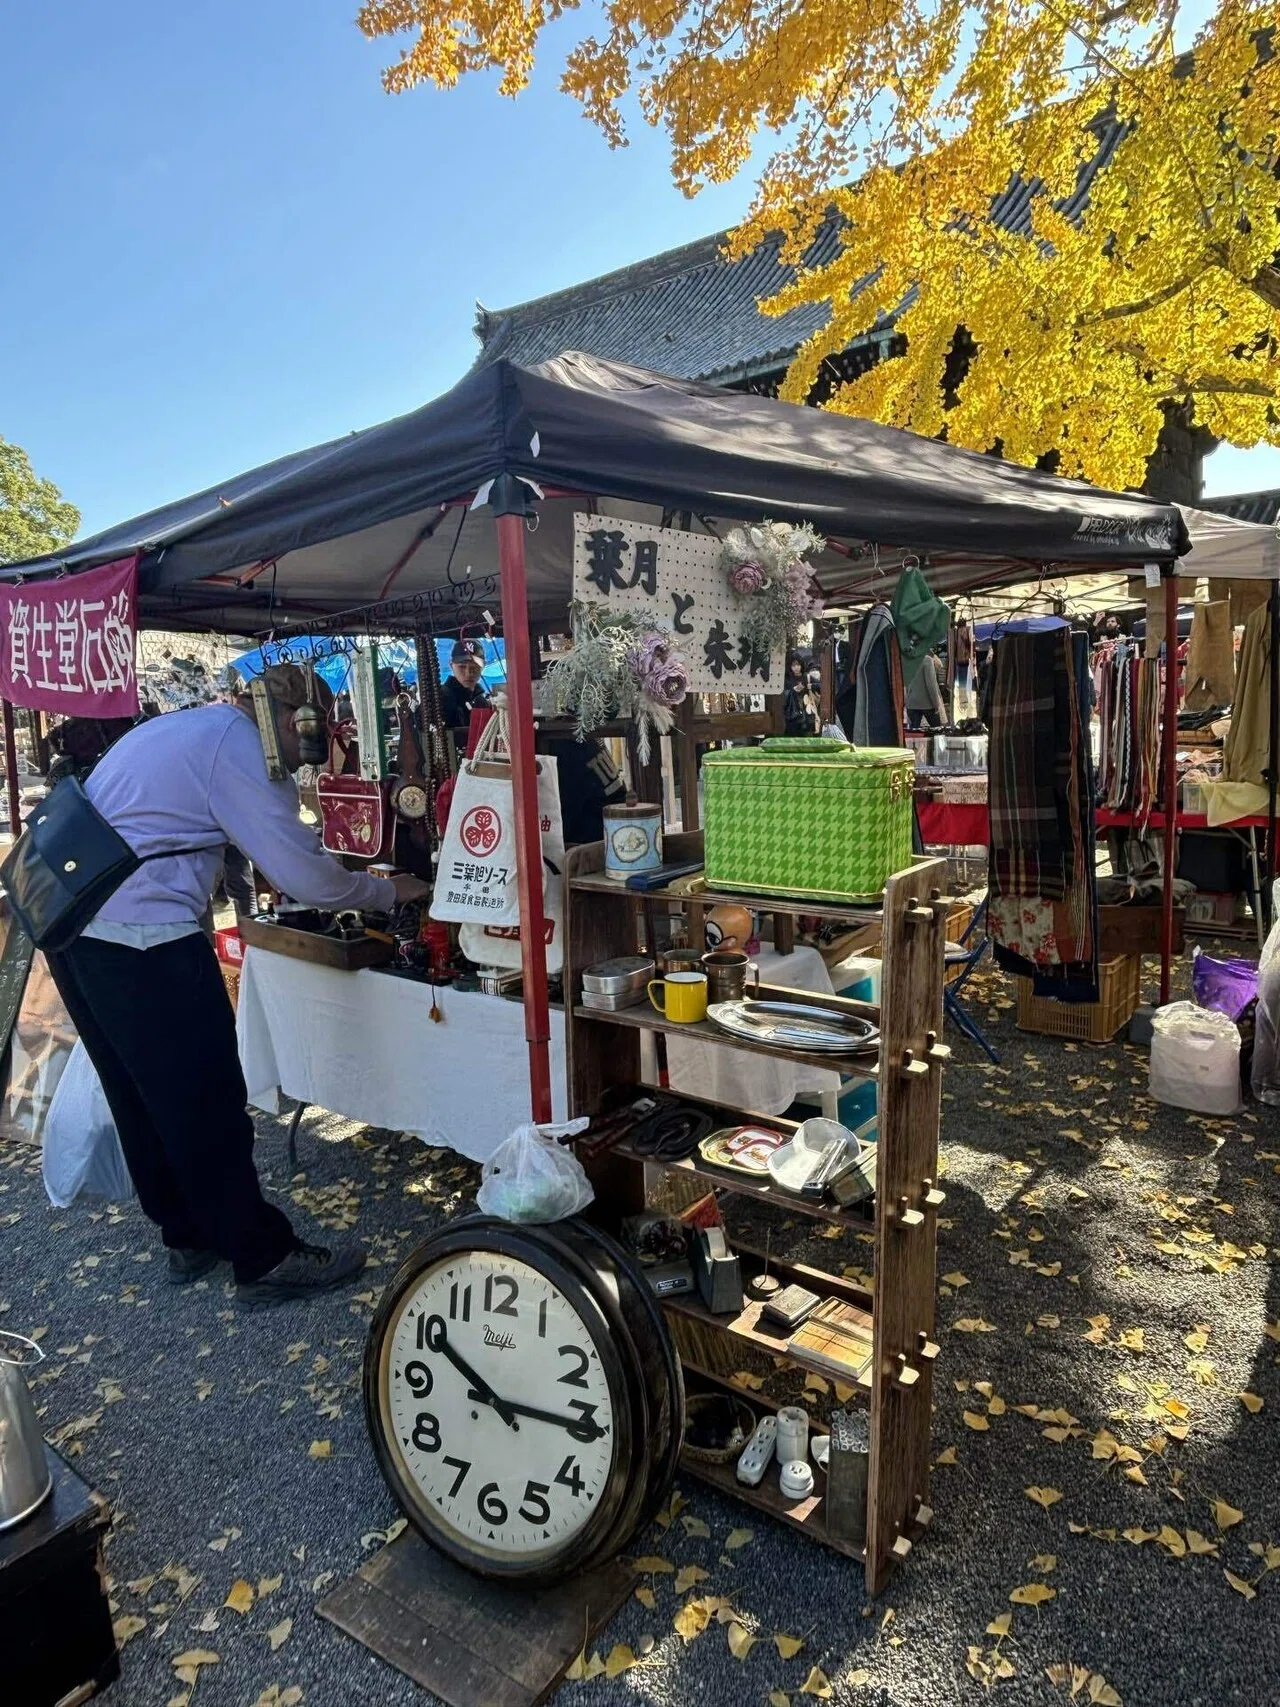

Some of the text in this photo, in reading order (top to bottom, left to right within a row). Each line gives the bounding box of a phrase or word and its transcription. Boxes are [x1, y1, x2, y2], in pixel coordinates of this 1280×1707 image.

[671, 592, 695, 634] と
[450, 1282, 472, 1322] 11
[483, 1273, 519, 1317] 12
[416, 1311, 447, 1353] 10
[483, 1324, 517, 1351] Meiji
[539, 1297, 548, 1338] 1
[405, 1360, 434, 1399] 9
[557, 1344, 590, 1389] 2
[412, 1412, 442, 1453] 8
[566, 1399, 600, 1444] 3
[442, 1455, 471, 1497] 7
[553, 1455, 586, 1497] 4
[477, 1482, 508, 1526] 6
[518, 1480, 551, 1525] 5
